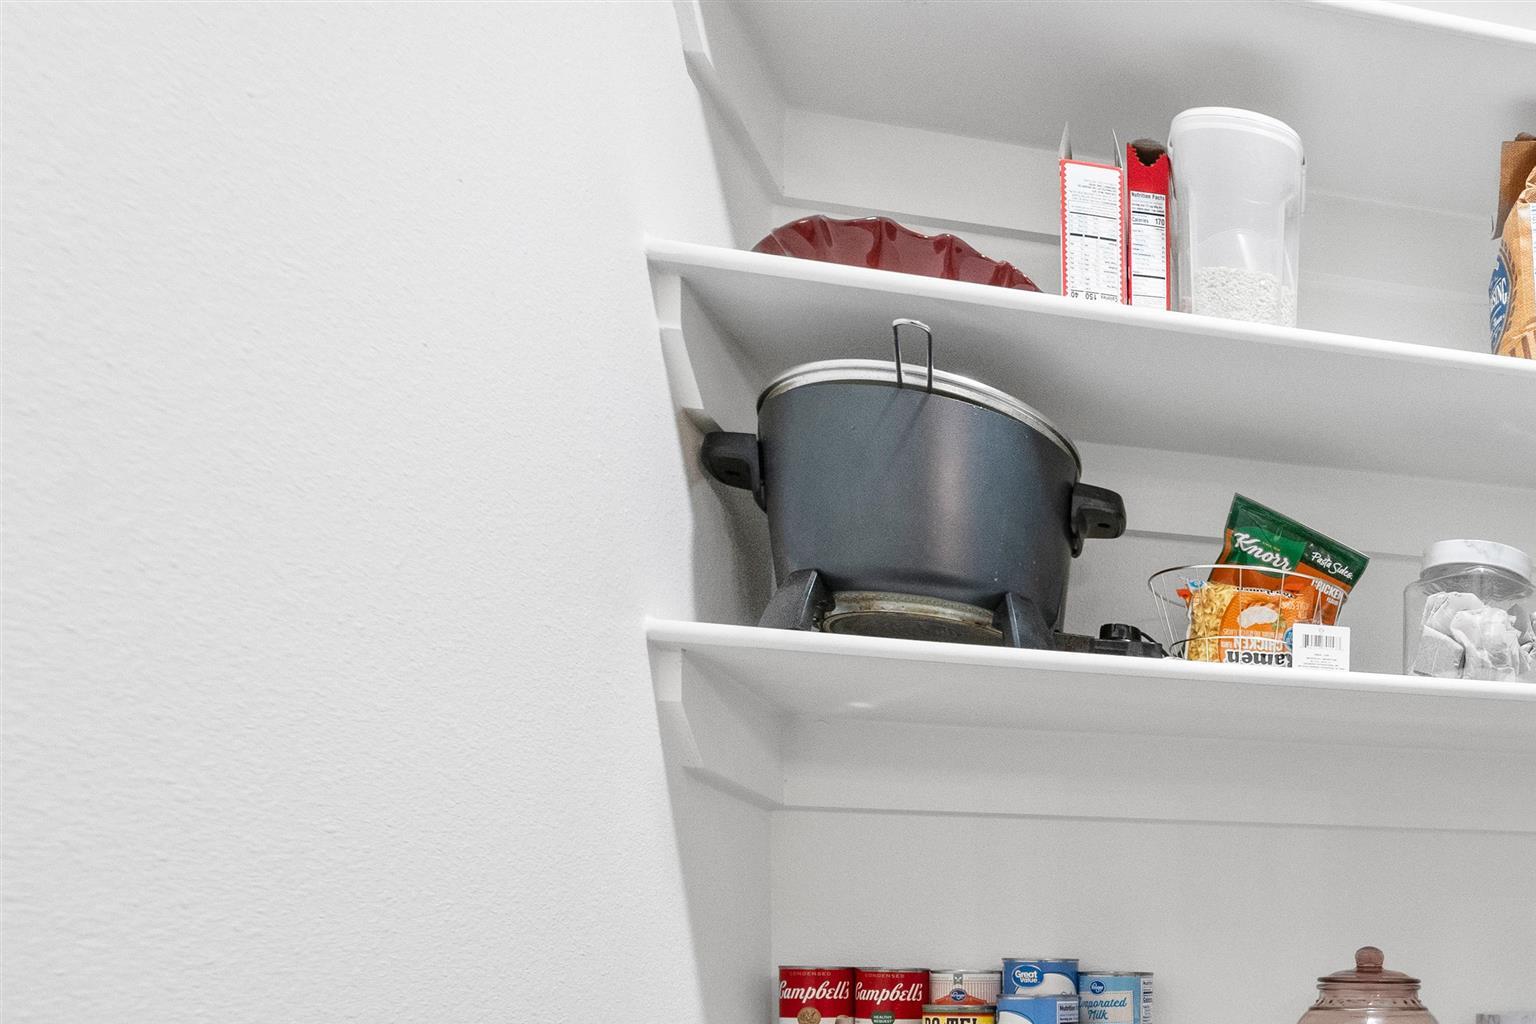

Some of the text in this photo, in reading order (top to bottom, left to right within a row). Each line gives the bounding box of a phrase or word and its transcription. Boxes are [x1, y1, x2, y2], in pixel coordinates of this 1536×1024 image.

[1155, 218, 1165, 226] 170
[1234, 532, 1291, 572] Knorr
[1311, 552, 1335, 568] Pasta
[1015, 970, 1037, 979] Great
[780, 980, 850, 1003] Campbell's
[855, 982, 923, 1005] Campbell's
[1079, 997, 1128, 1008] aporated
[1088, 1009, 1108, 1020] Milk
